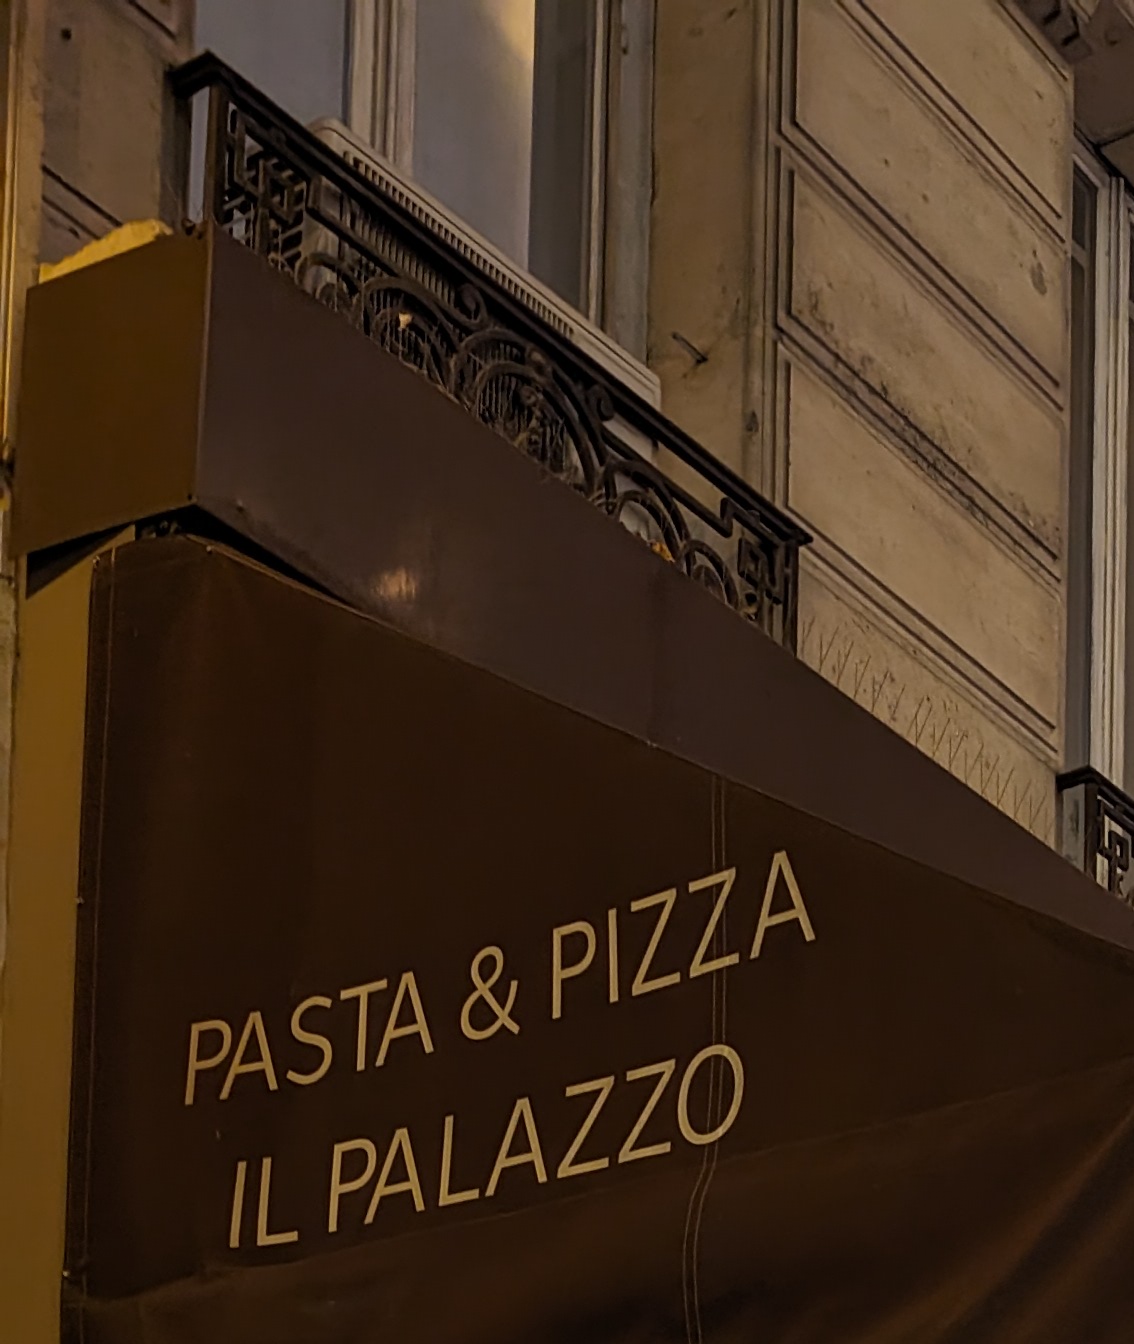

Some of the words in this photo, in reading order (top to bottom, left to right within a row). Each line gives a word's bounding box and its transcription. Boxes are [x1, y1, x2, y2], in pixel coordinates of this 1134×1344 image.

[184, 970, 434, 1106] PASTA
[460, 944, 520, 1041] &
[552, 850, 816, 1020] PIZZA
[229, 1156, 298, 1249] IL
[328, 1043, 745, 1234] PALAZZO
